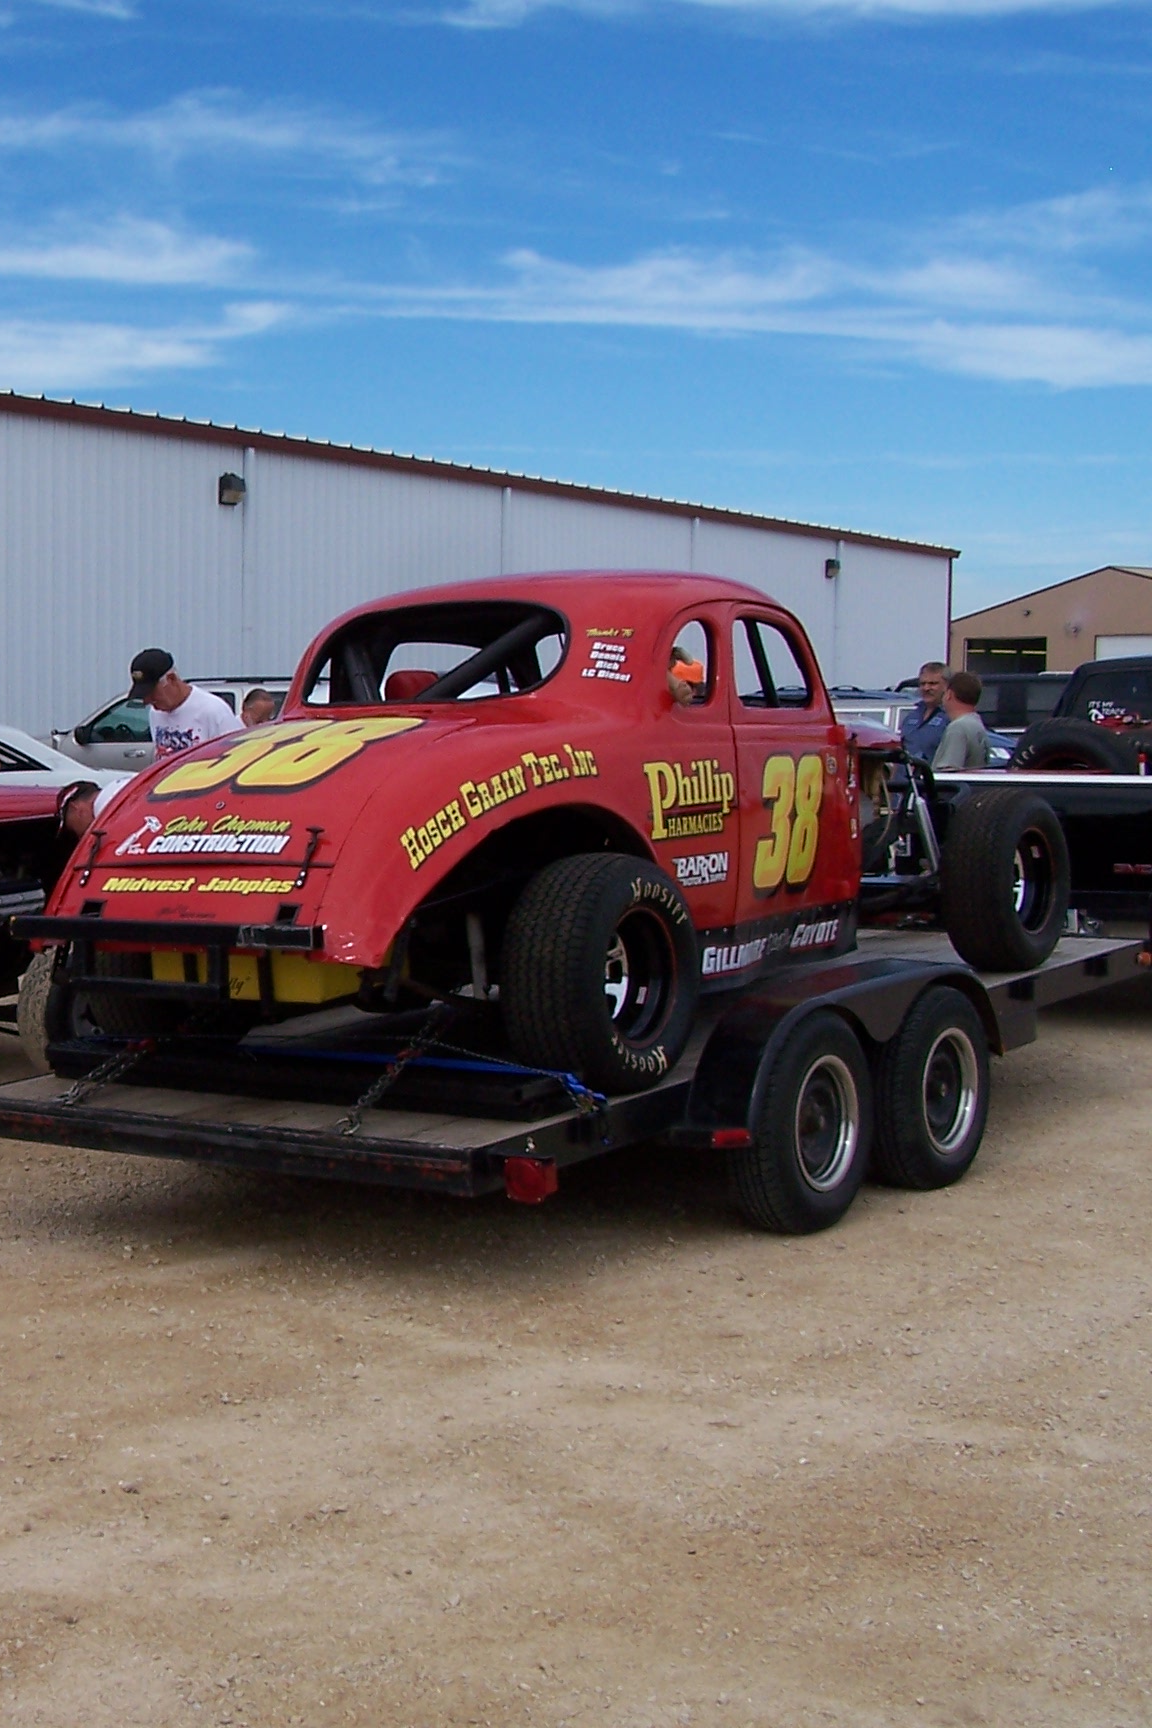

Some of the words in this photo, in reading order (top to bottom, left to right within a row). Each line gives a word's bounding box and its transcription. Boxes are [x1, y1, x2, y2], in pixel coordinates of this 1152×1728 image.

[589, 650, 627, 663] Dennis
[592, 641, 626, 653] Bruce
[595, 660, 620, 671] Rich
[597, 669, 631, 682] Diesel
[150, 716, 425, 798] 38
[459, 765, 527, 819] GRAIN
[643, 759, 734, 840] Phillip
[164, 815, 208, 836] John
[212, 815, 292, 834] Chapman
[753, 754, 824, 890] 38
[148, 835, 290, 854] CONSTRUCTION
[101, 877, 196, 892] Midwest
[198, 877, 297, 895] Jalopies
[790, 919, 839, 949] COYOTE
